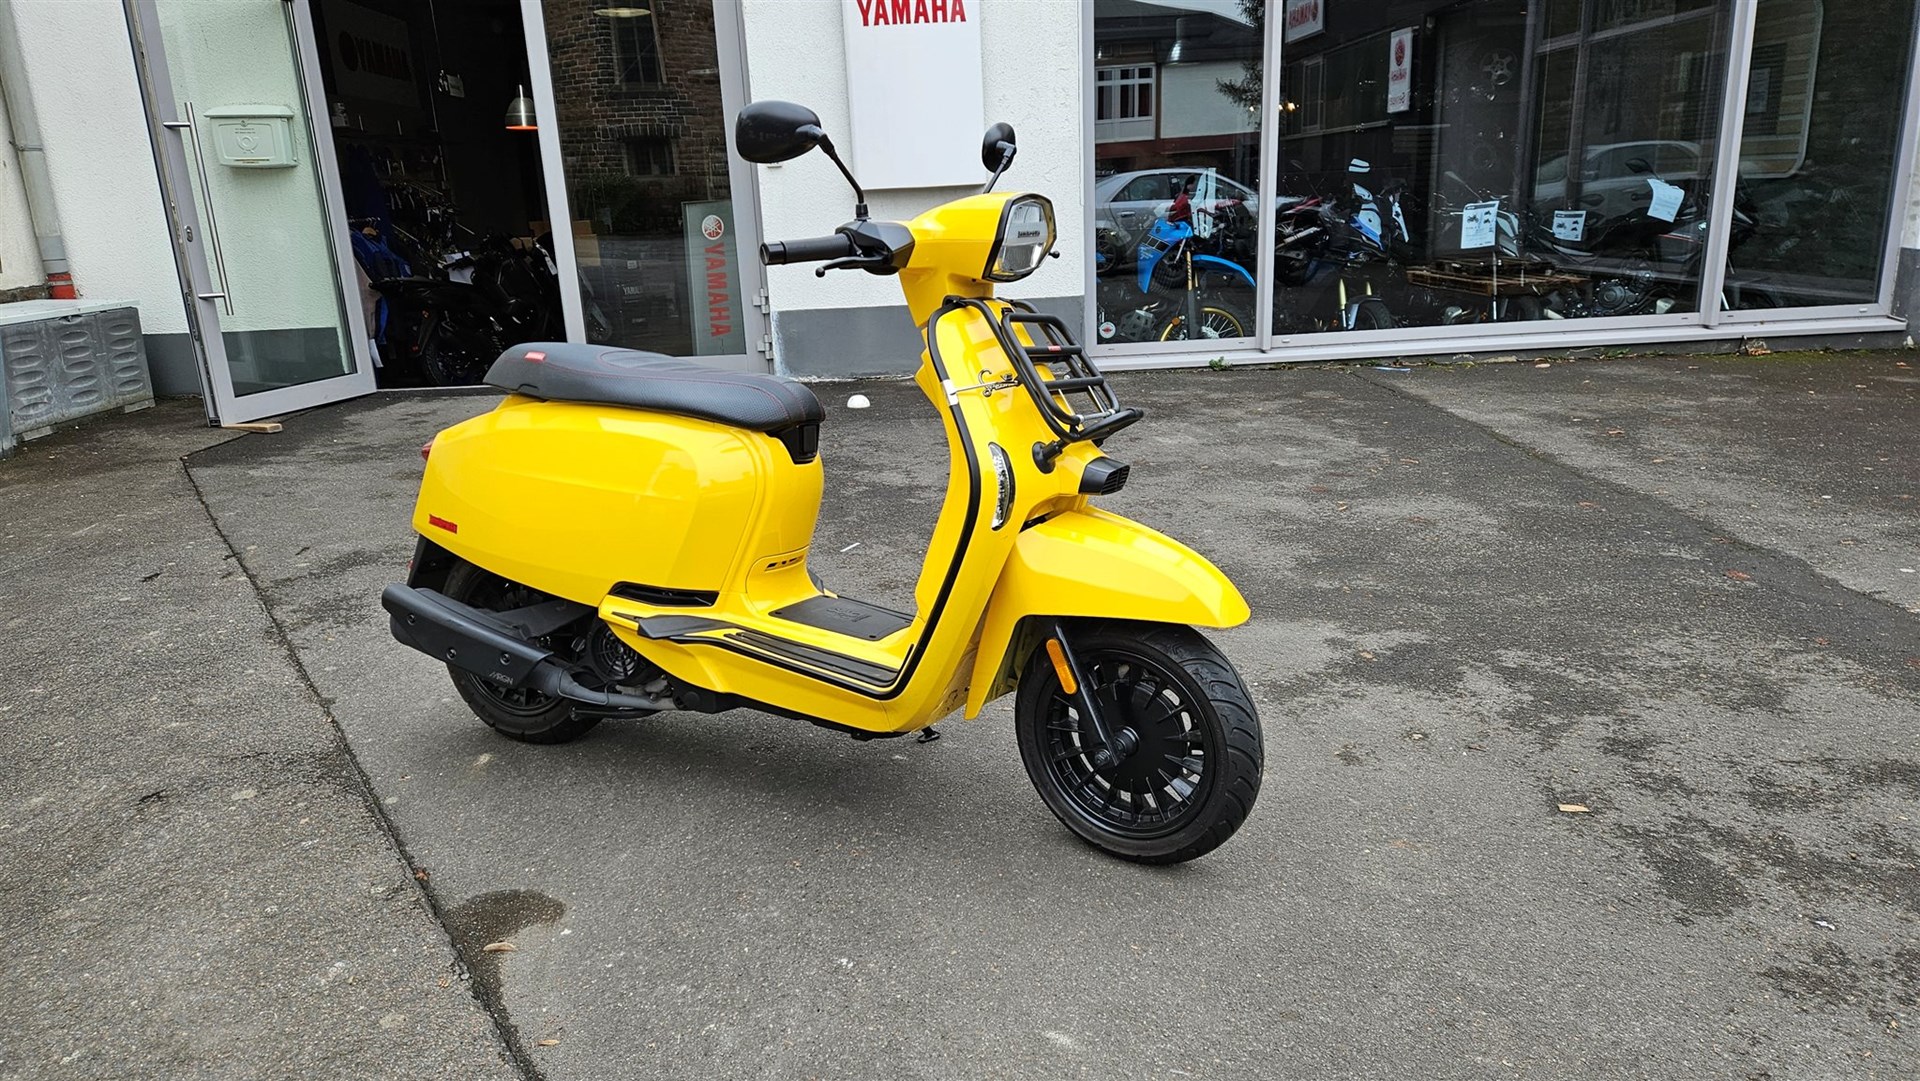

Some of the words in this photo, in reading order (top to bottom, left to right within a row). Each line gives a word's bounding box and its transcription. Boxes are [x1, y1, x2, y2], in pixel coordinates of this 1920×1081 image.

[856, 0, 966, 26] YAMAHA
[354, 37, 413, 82] YAMAHA
[704, 242, 732, 337] YAMAHA
